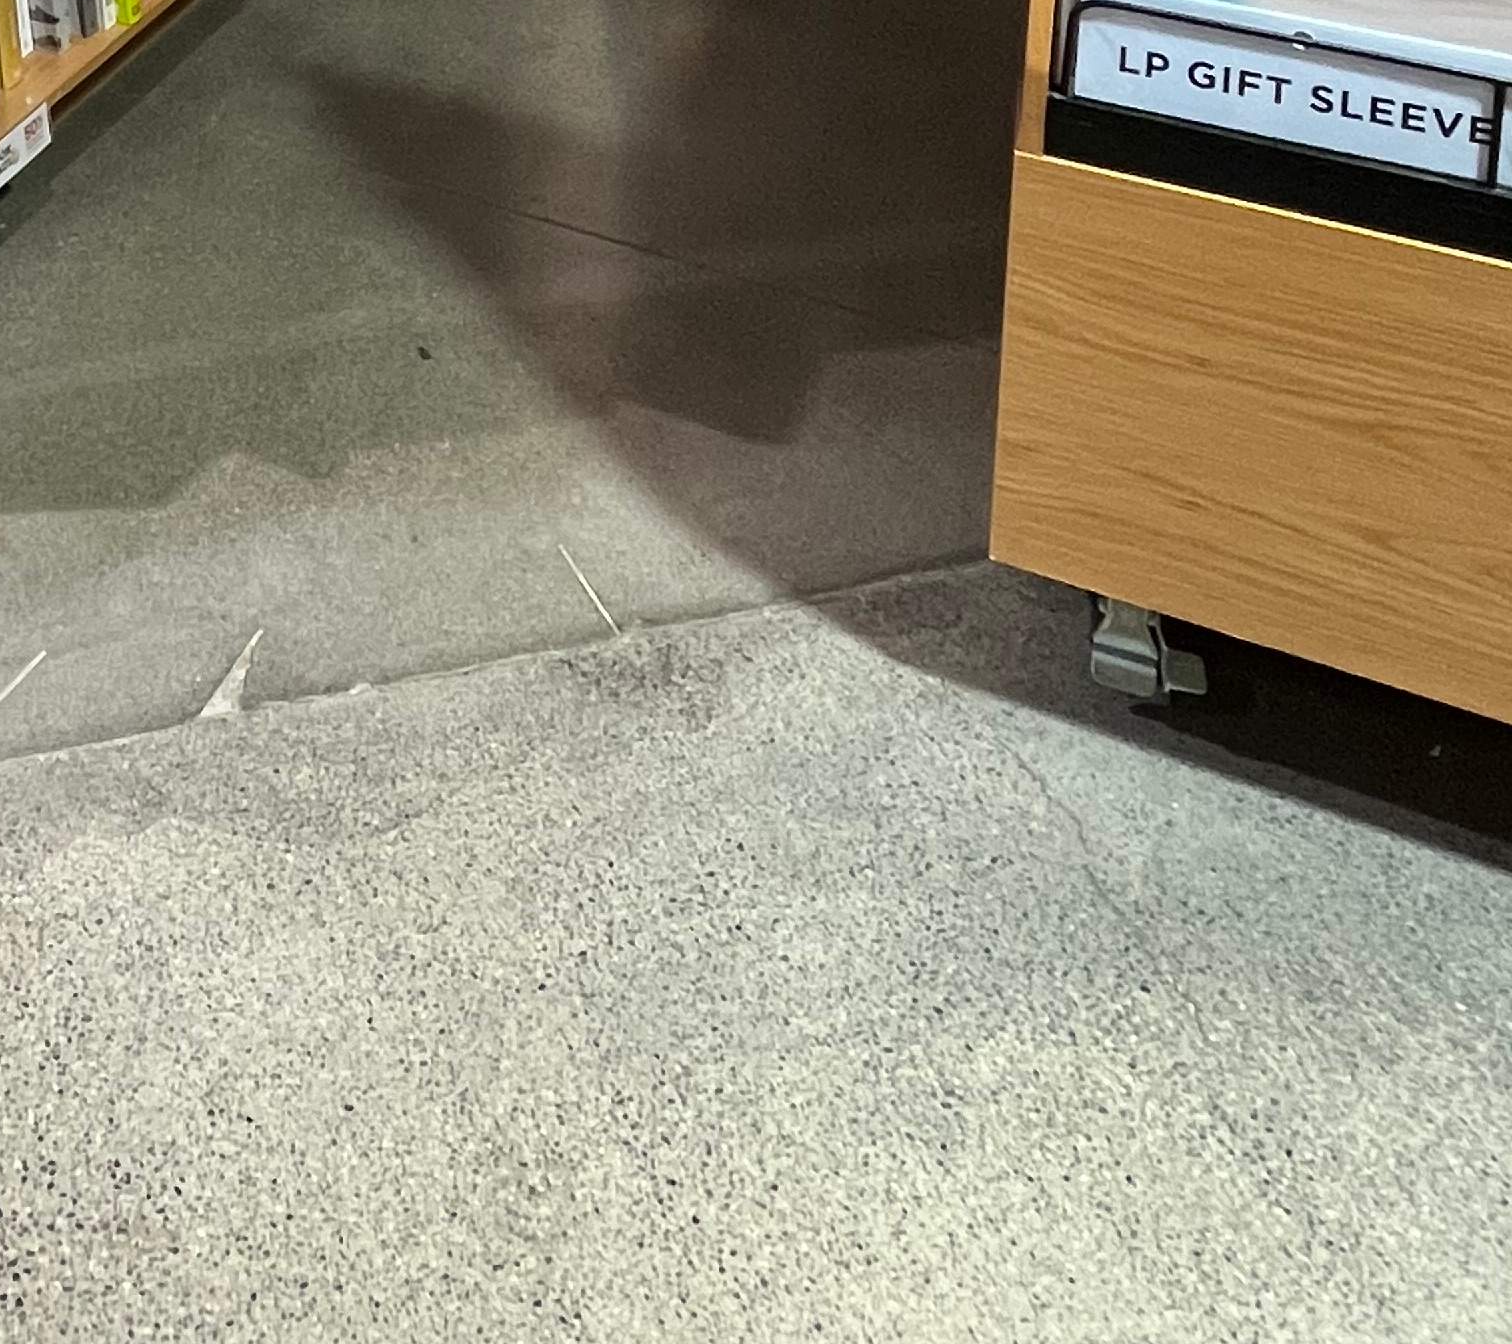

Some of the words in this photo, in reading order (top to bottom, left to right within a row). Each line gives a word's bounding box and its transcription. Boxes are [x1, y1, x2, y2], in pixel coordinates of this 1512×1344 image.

[1117, 45, 1171, 79] LP
[1187, 60, 1293, 105] GIFT
[1309, 84, 1494, 146] SLEEVE
